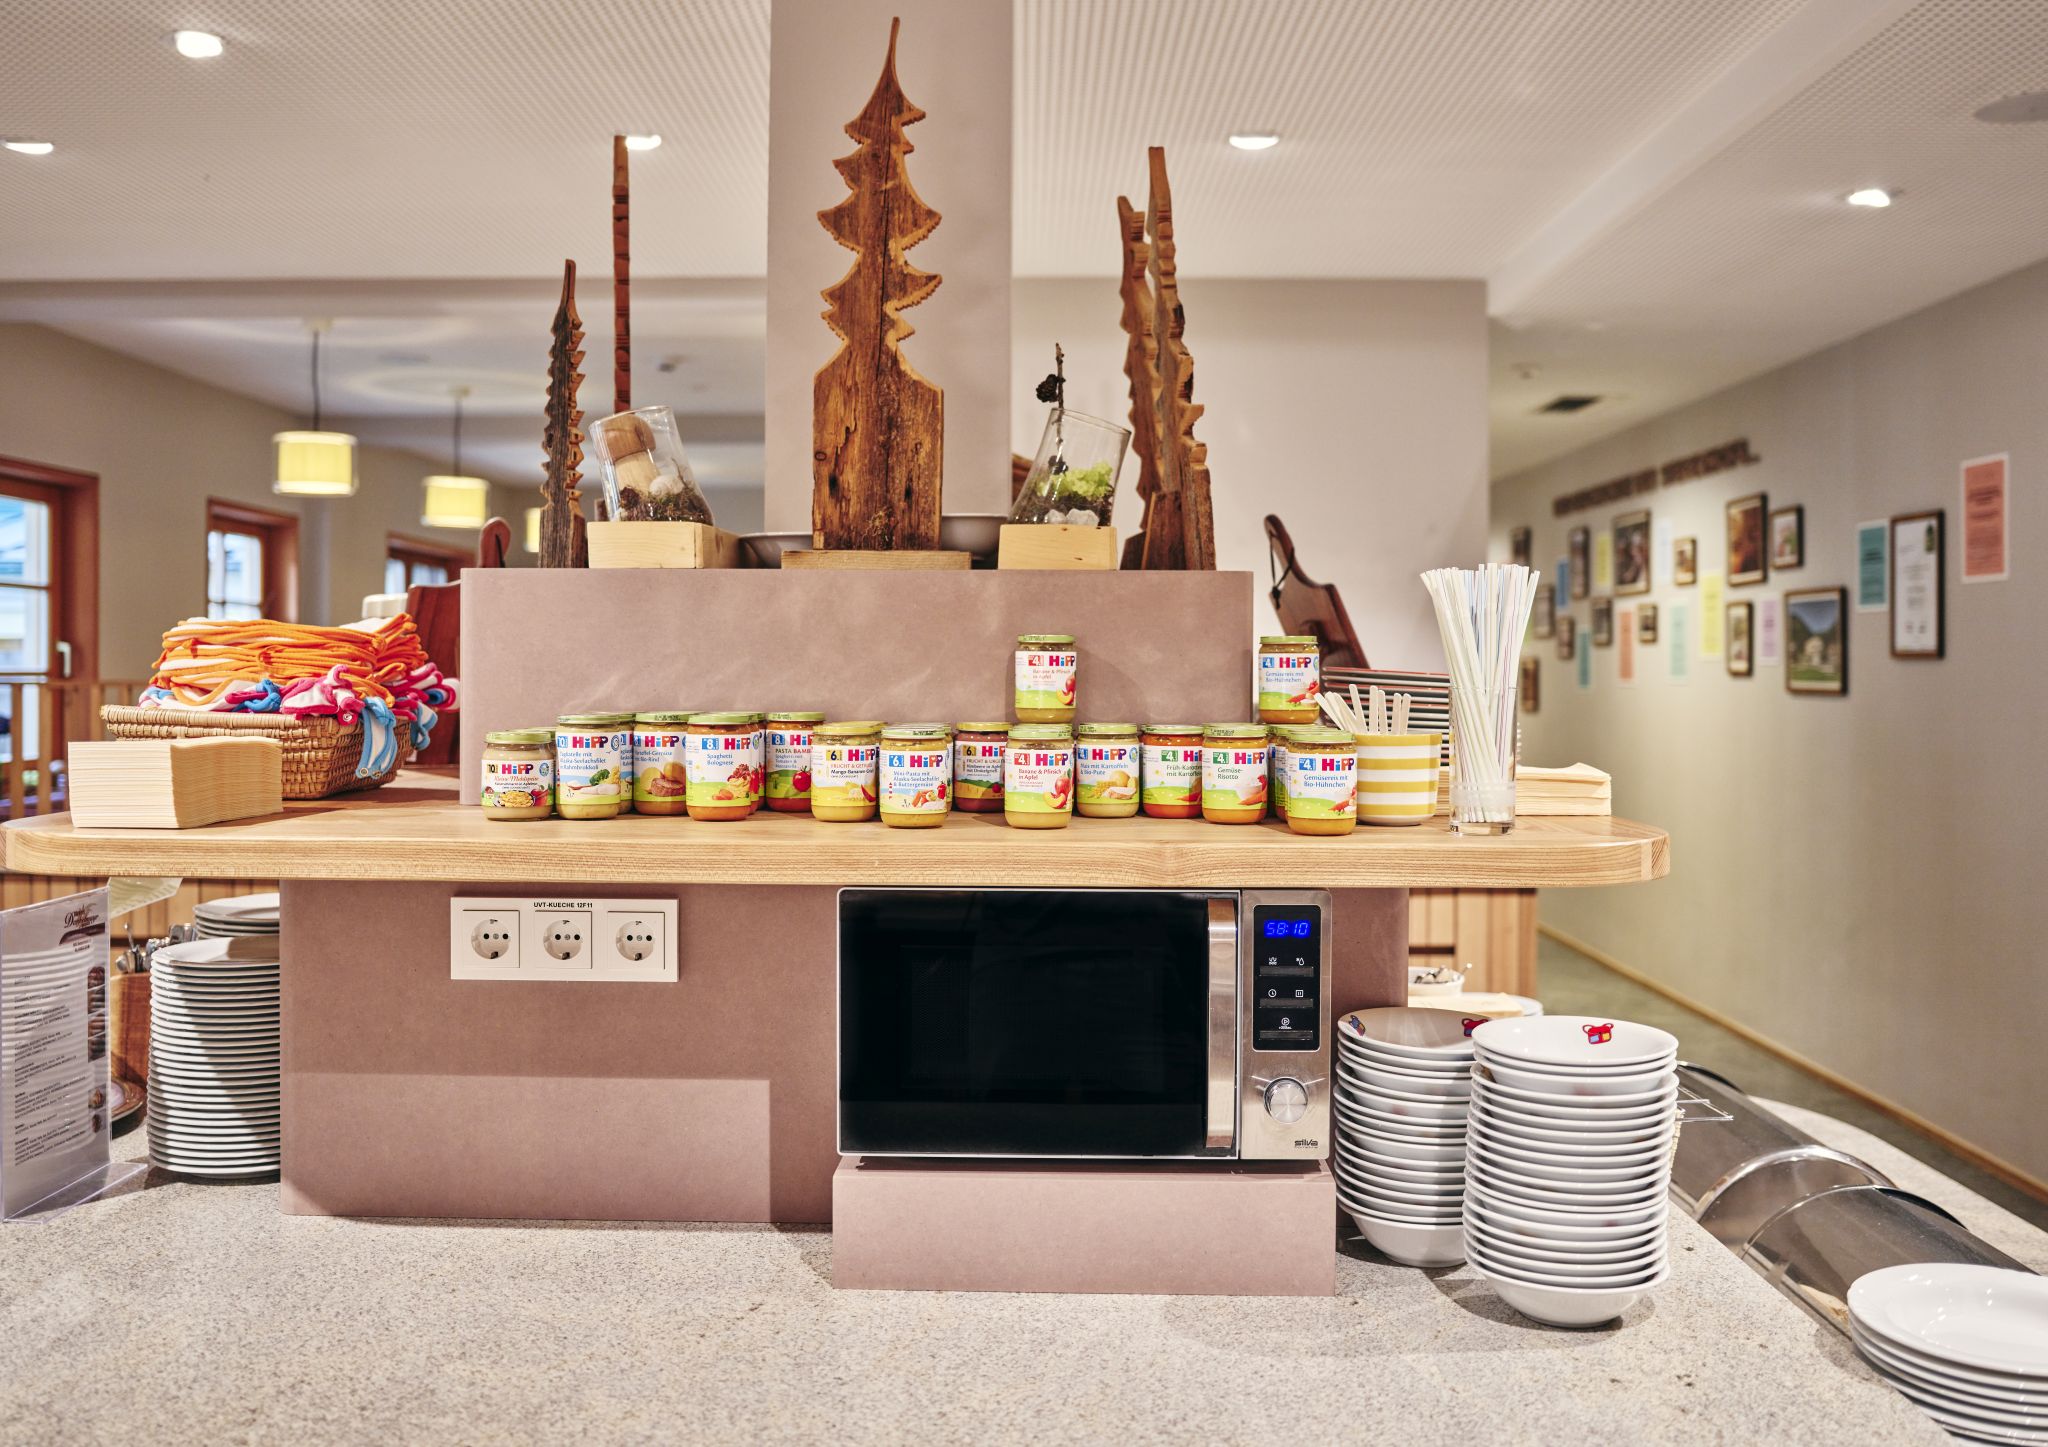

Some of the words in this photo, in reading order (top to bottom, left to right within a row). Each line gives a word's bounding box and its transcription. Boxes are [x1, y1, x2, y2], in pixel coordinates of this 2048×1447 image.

[1049, 655, 1075, 667] HiPP
[1279, 656, 1312, 668] HiPP
[572, 736, 609, 748] HiPP
[645, 735, 680, 747] HiPP
[1035, 753, 1069, 766] HiPP
[1092, 748, 1127, 760] HiPP
[1234, 752, 1265, 765] HiPP
[910, 755, 943, 768] HiPP
[1321, 758, 1355, 771] HiPP
[501, 764, 534, 774] HiPP
[1304, 780, 1346, 788] Bio-Hühnchen
[1266, 922, 1309, 935] 58:10
